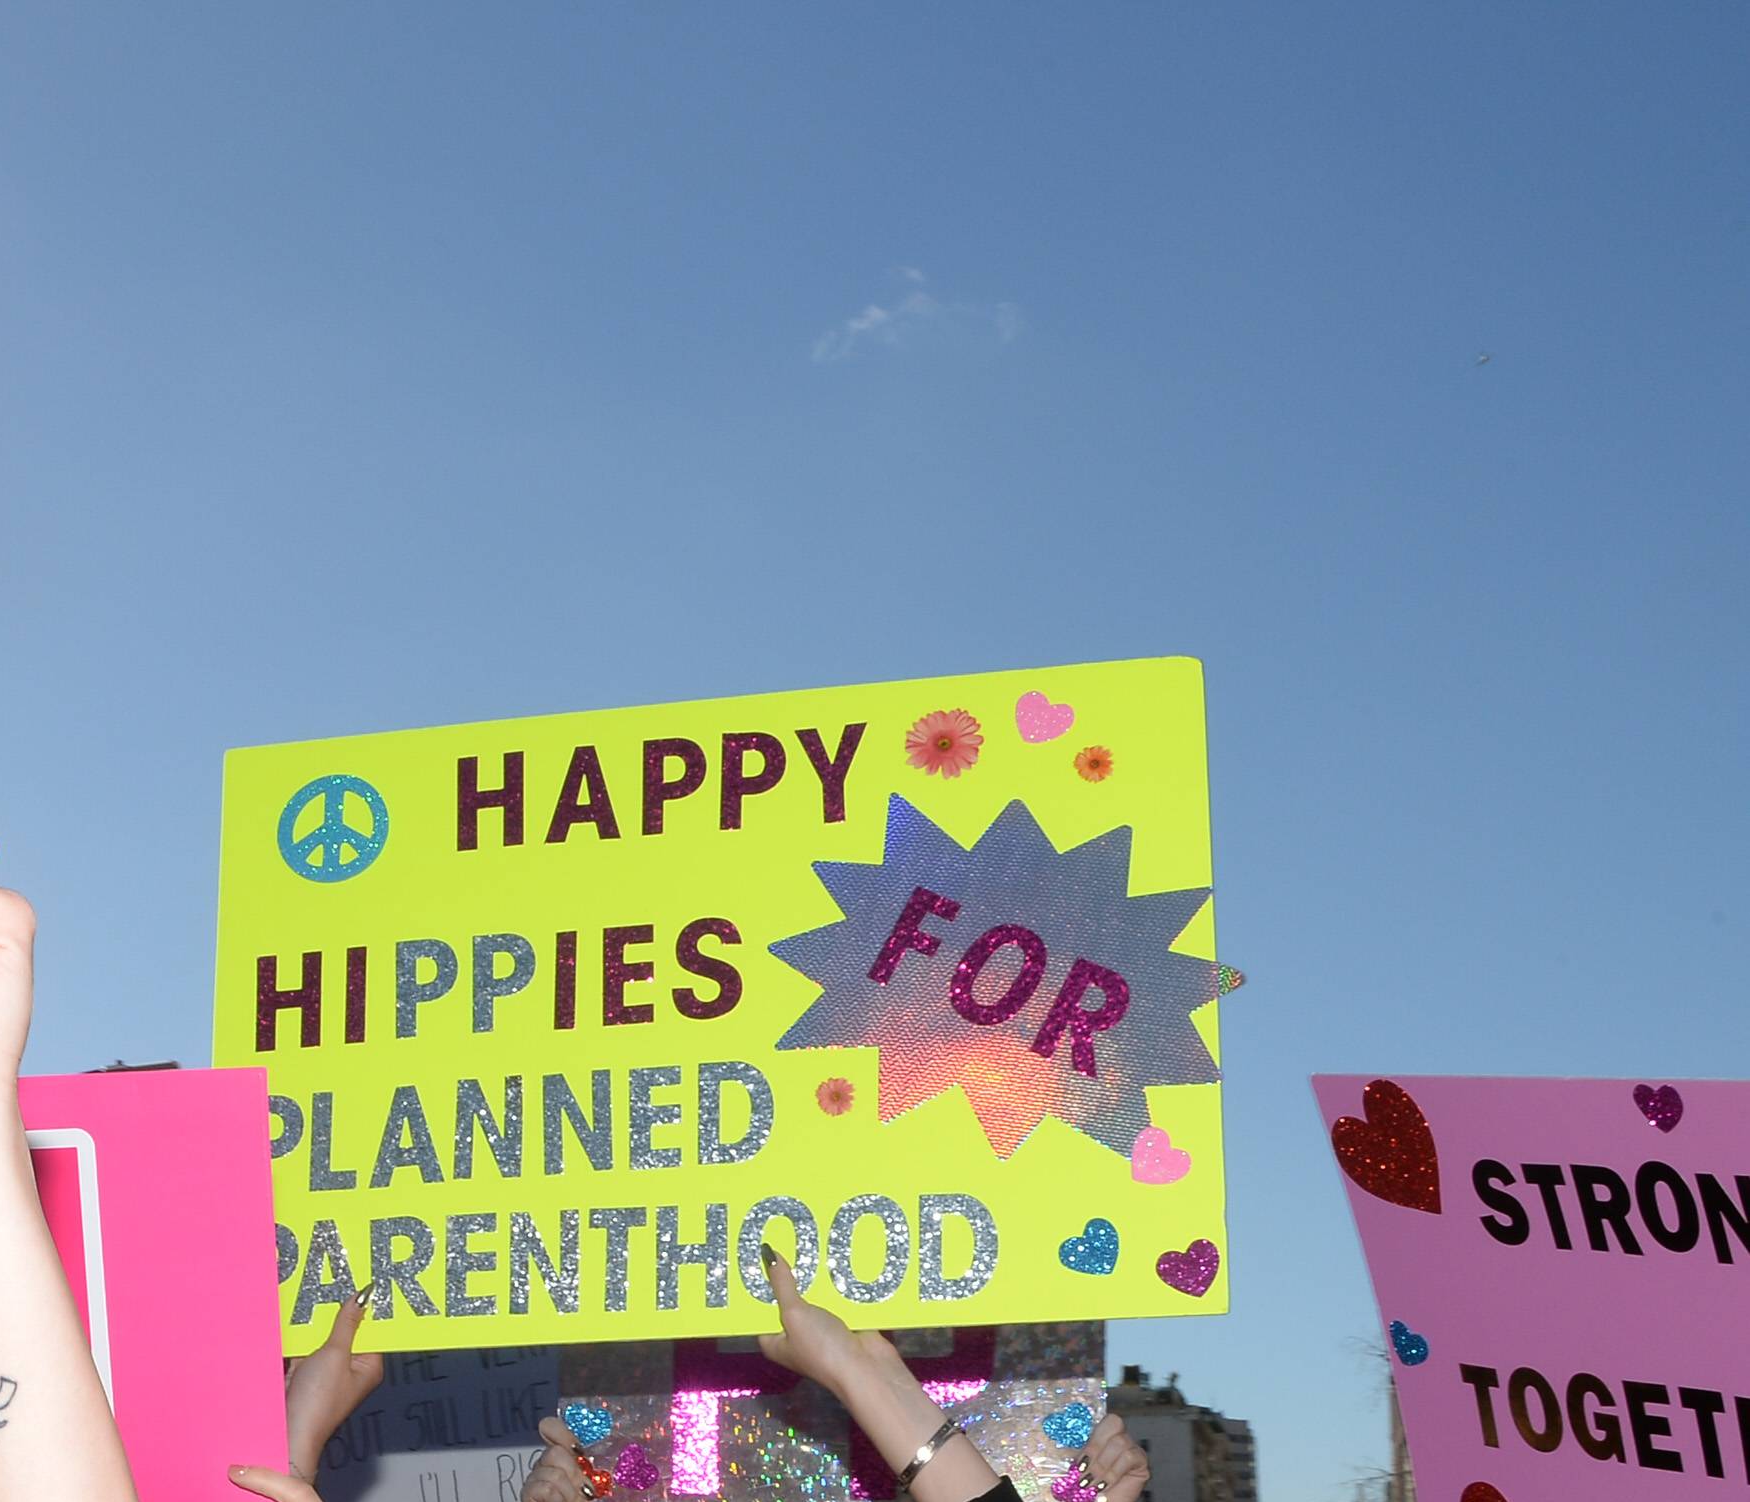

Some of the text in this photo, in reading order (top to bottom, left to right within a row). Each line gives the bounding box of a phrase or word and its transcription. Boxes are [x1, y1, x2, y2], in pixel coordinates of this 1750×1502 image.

[457, 722, 867, 852] HAPPY
[254, 916, 744, 1054] HIPPIES
[866, 884, 1131, 1078] FOR
[1472, 1159, 1750, 1265] STRON
[327, 1410, 386, 1471] BUT
[481, 1380, 551, 1440] LIKE
